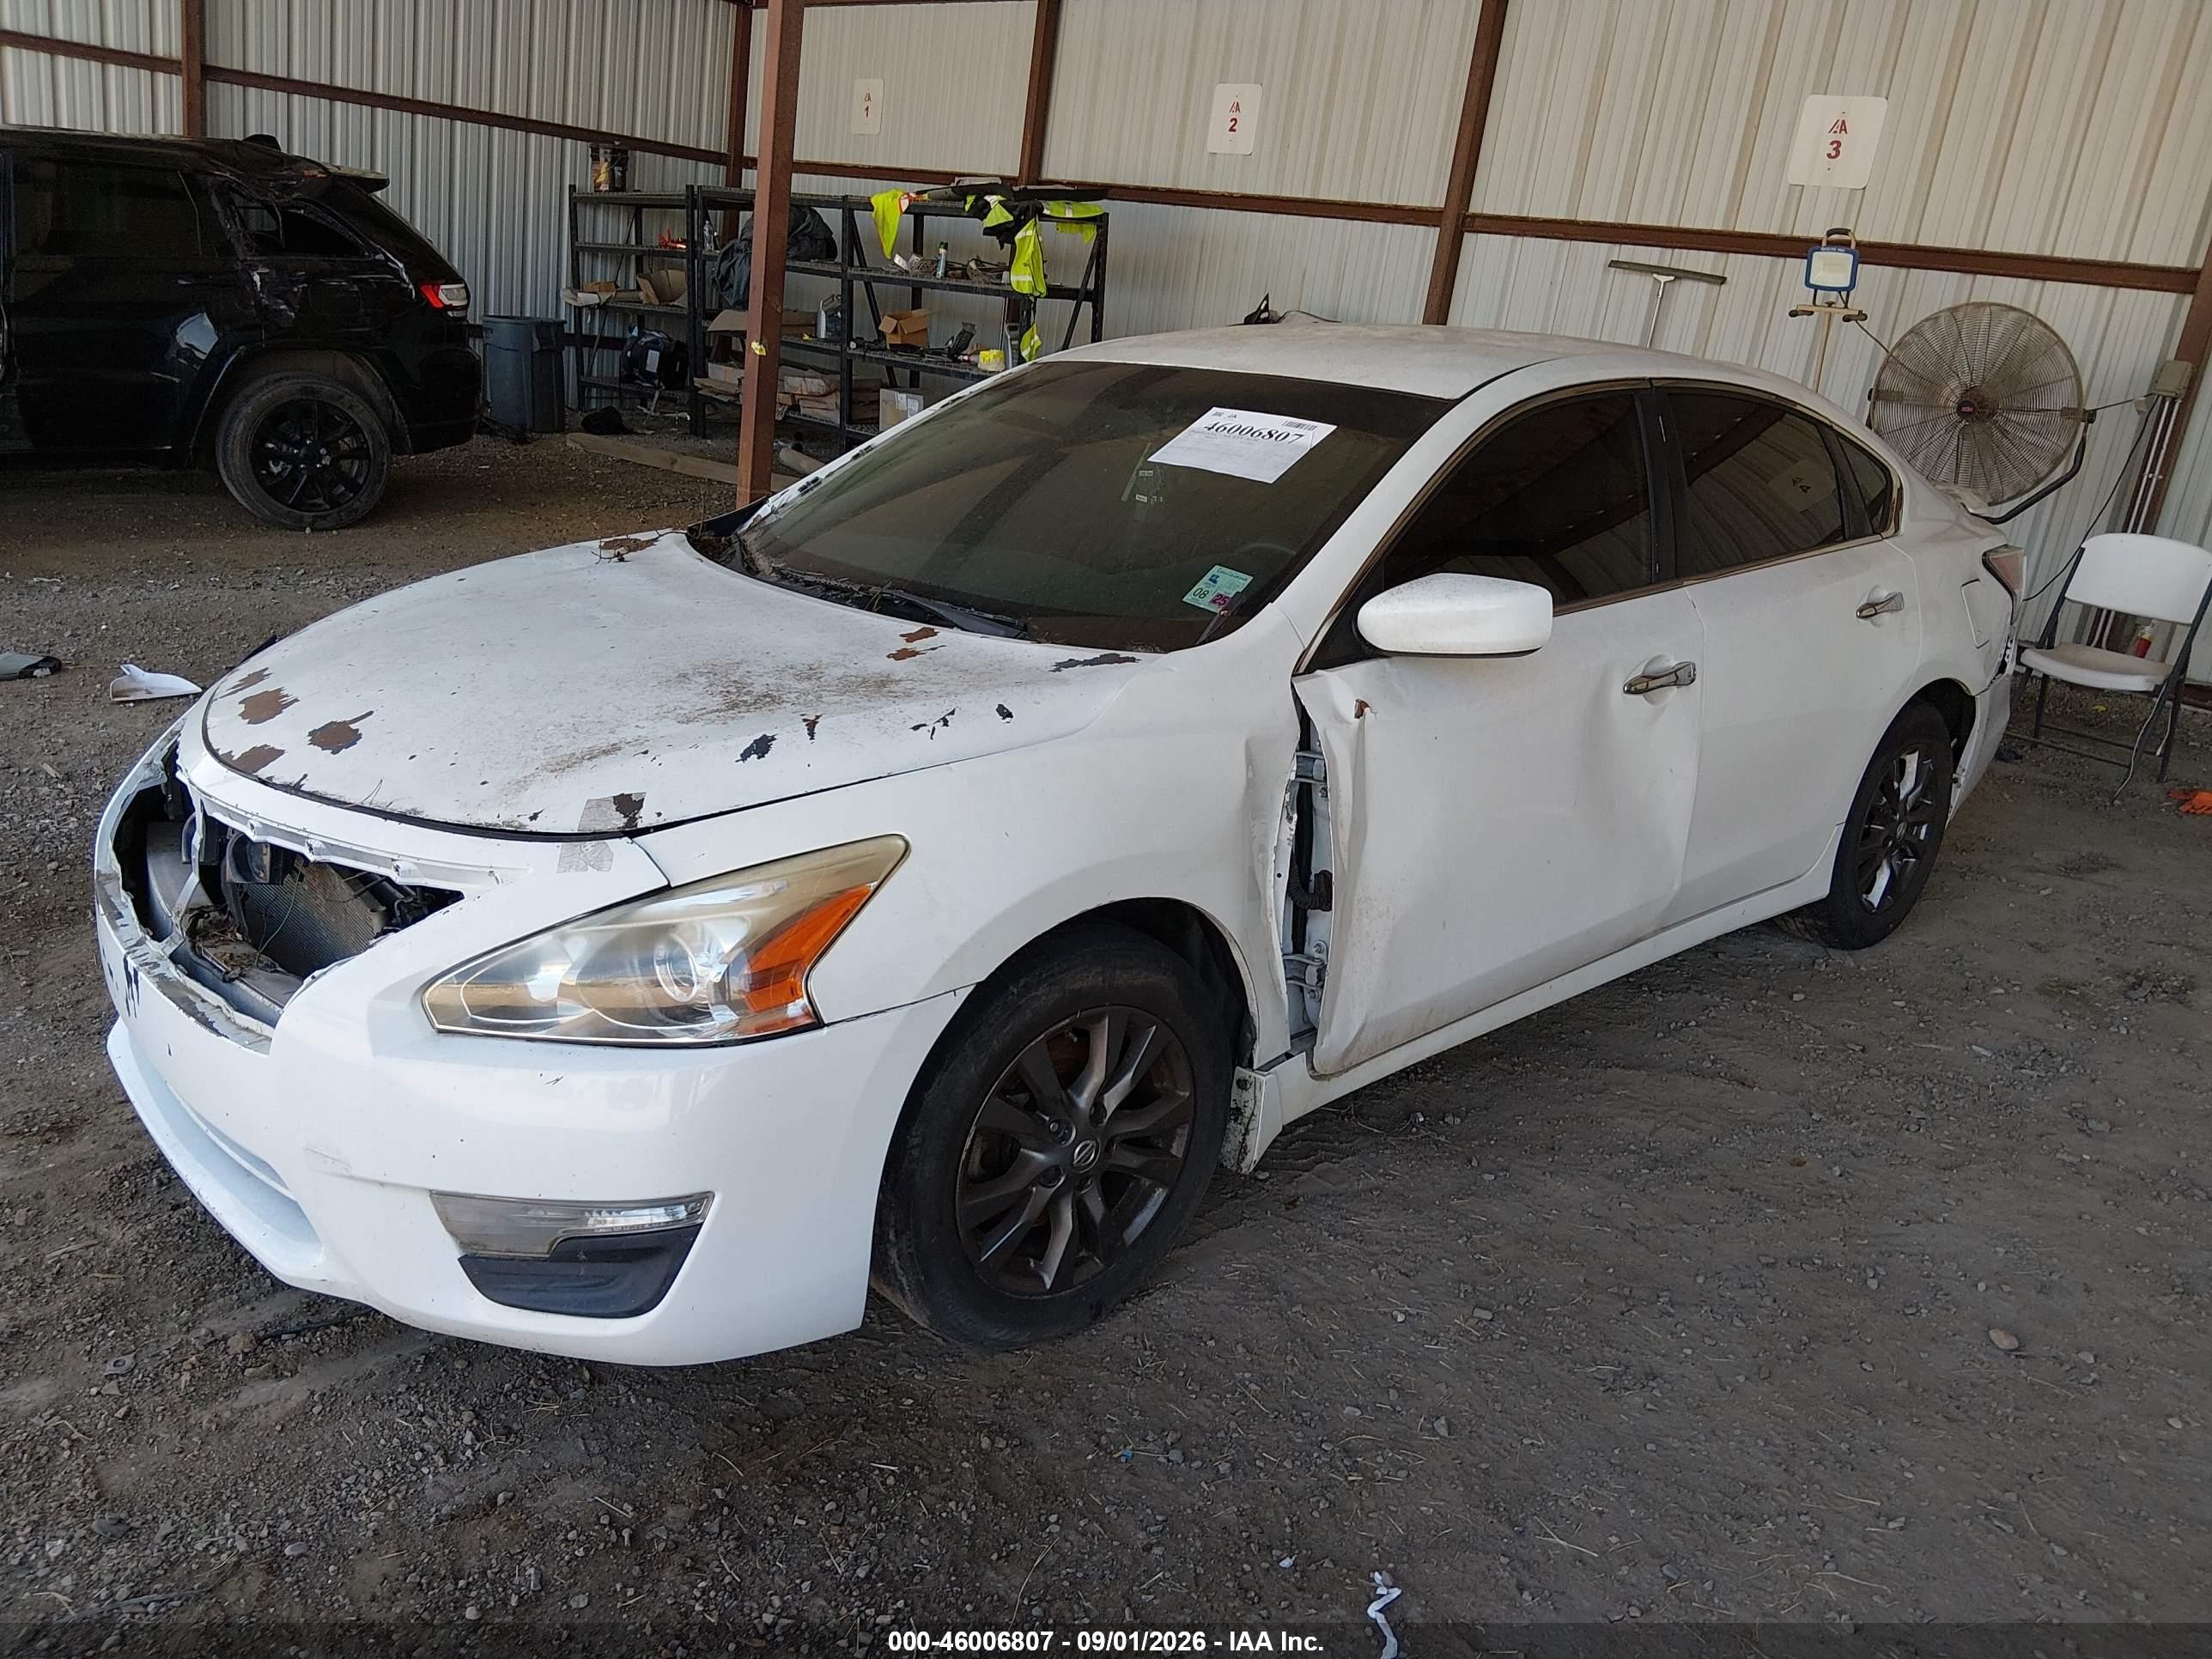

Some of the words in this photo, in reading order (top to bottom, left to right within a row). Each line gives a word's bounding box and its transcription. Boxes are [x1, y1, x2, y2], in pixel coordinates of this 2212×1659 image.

[864, 105, 870, 118] 1
[1228, 117, 1238, 132] 2
[1826, 139, 1842, 160] 3
[1204, 422, 1305, 444] 46006807
[1192, 587, 1210, 599] 08
[1212, 593, 1230, 606] 25
